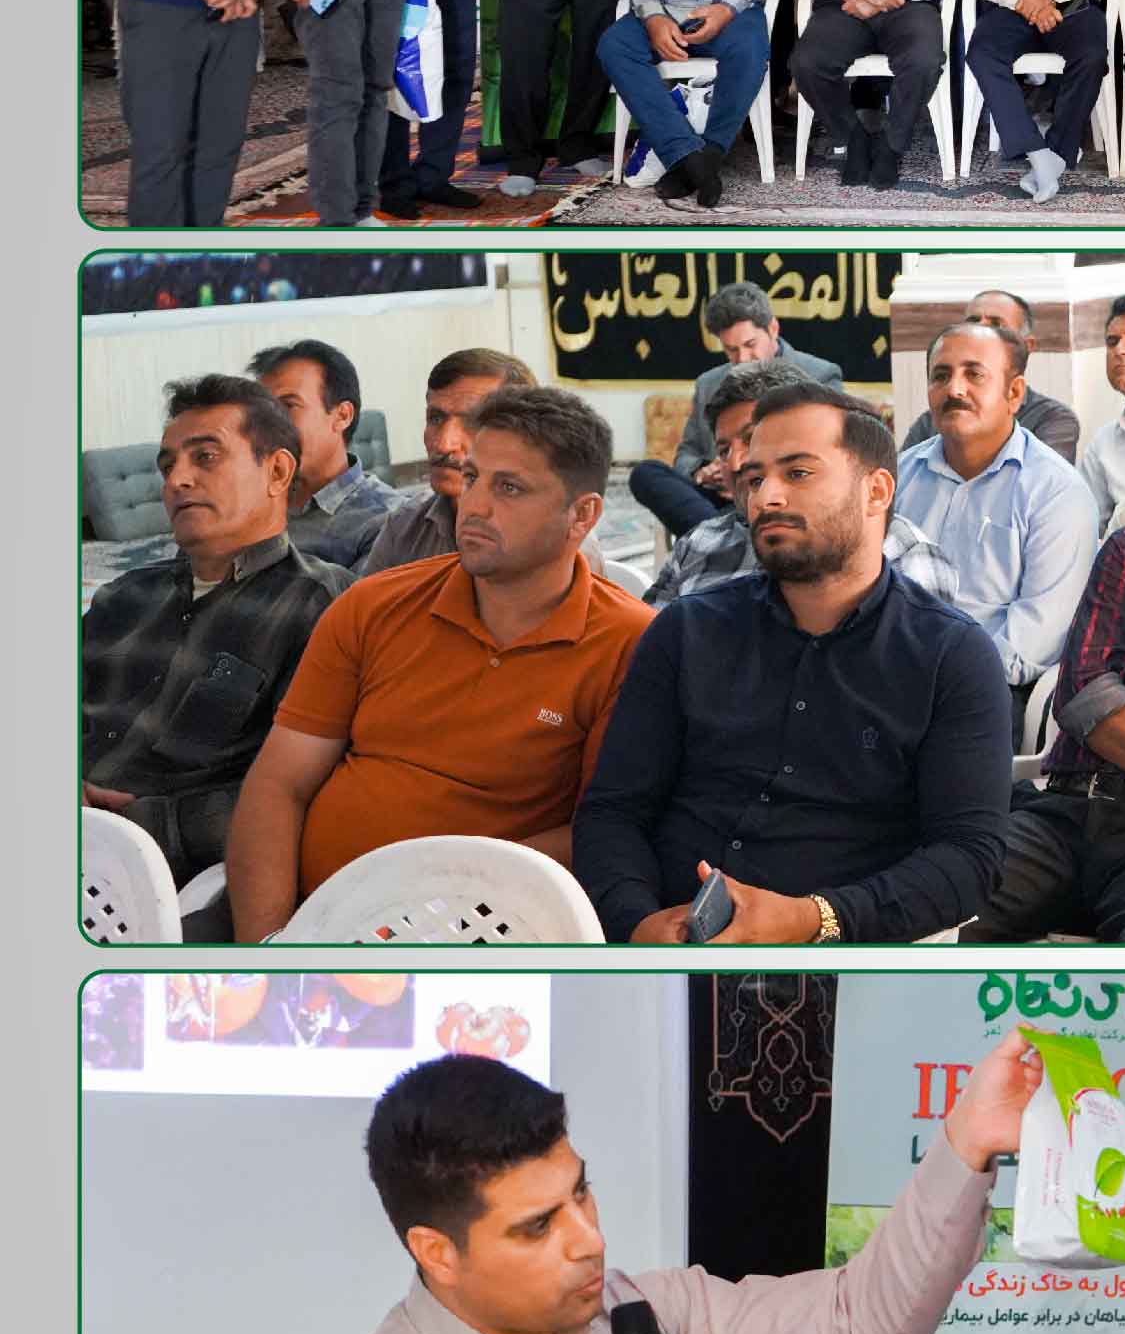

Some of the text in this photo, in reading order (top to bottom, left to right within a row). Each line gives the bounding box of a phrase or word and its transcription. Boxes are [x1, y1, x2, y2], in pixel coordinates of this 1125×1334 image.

[968, 1271, 1026, 1297] زندگی
[1032, 1272, 1073, 1293] خاک
[1078, 1277, 1098, 1297] به
[988, 1308, 1029, 1326] عوامل
[1034, 1308, 1062, 1327] برابر
[1066, 1311, 1080, 1327] در
